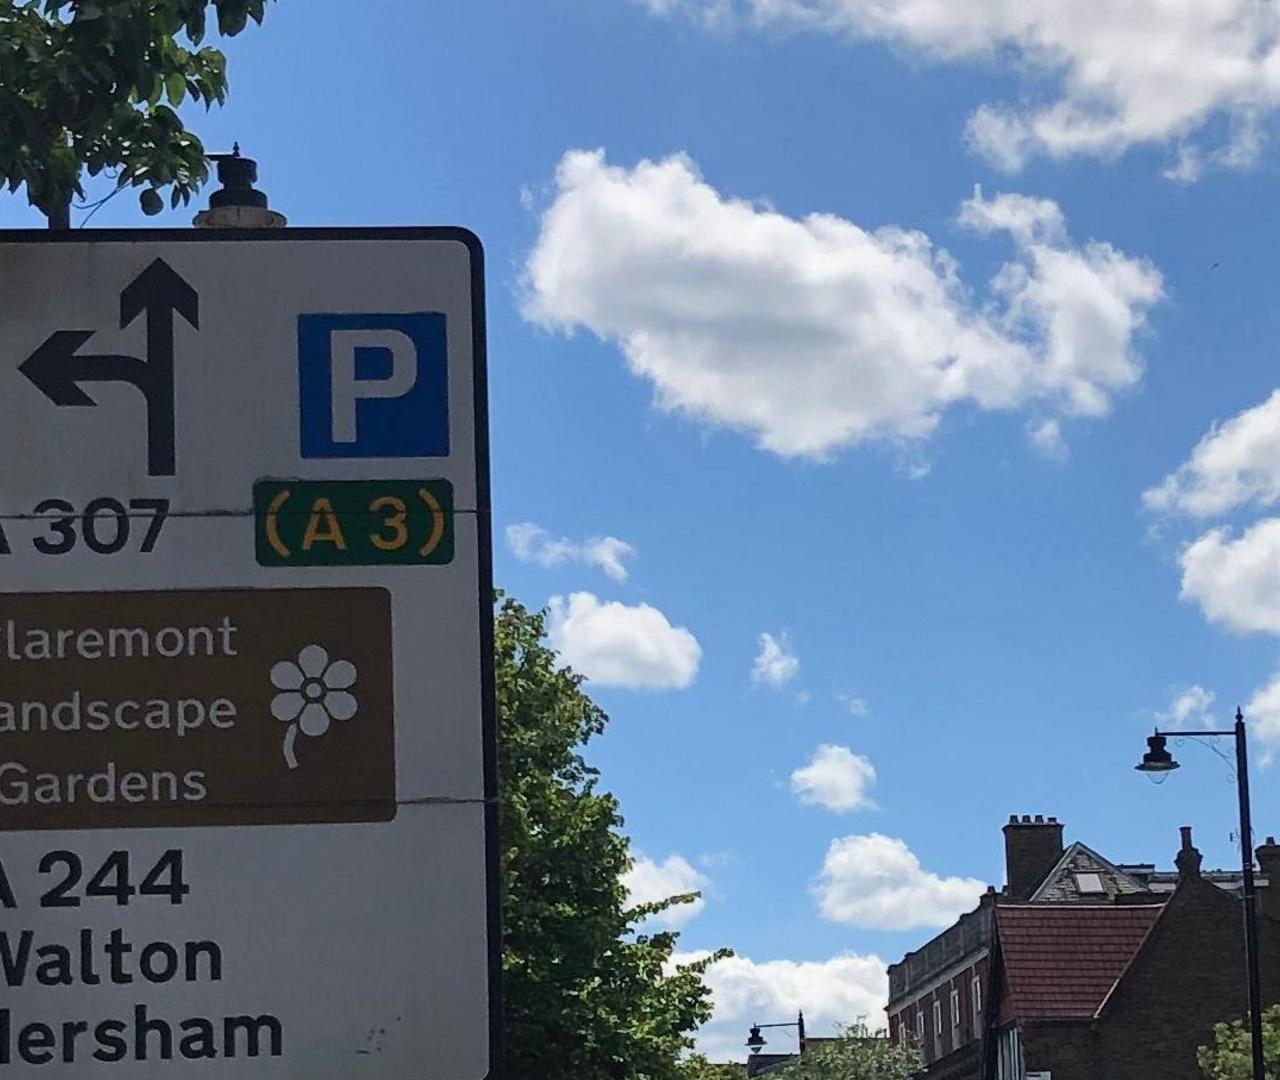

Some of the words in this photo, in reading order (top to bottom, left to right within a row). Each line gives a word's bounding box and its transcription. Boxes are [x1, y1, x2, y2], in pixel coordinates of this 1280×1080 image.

[330, 329, 418, 443] P
[33, 498, 171, 555] 307
[39, 848, 190, 908] 244
